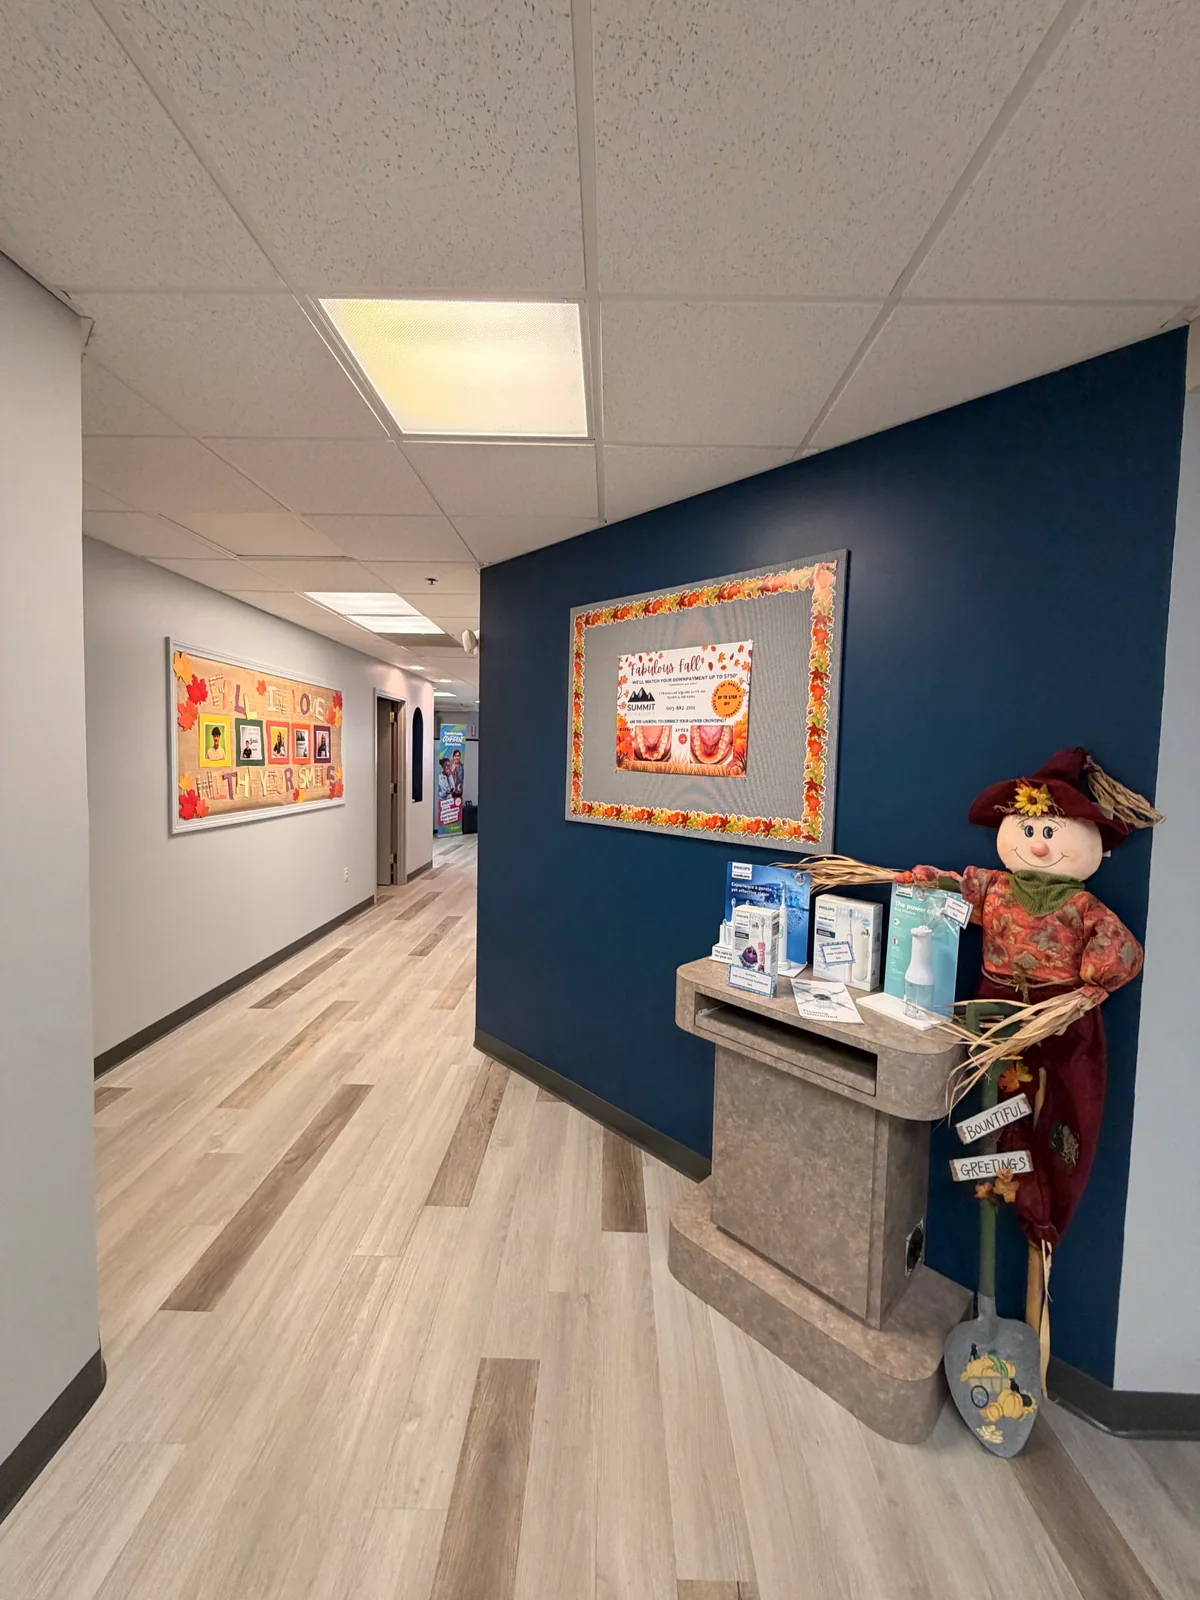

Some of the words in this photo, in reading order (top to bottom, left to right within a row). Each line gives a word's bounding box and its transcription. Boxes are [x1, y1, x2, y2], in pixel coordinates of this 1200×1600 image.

[631, 659, 675, 676] Fabulous
[679, 654, 701, 673] Fall
[267, 686, 287, 714] IN
[292, 689, 325, 721] LOVE
[627, 703, 655, 711] SUMMIT
[260, 767, 294, 797] YOUR
[731, 881, 754, 889] Experience
[895, 900, 905, 908] The
[906, 903, 926, 913] power
[966, 1102, 1026, 1140] BOUNTIFUL
[960, 1156, 1026, 1178] GREETINGS
